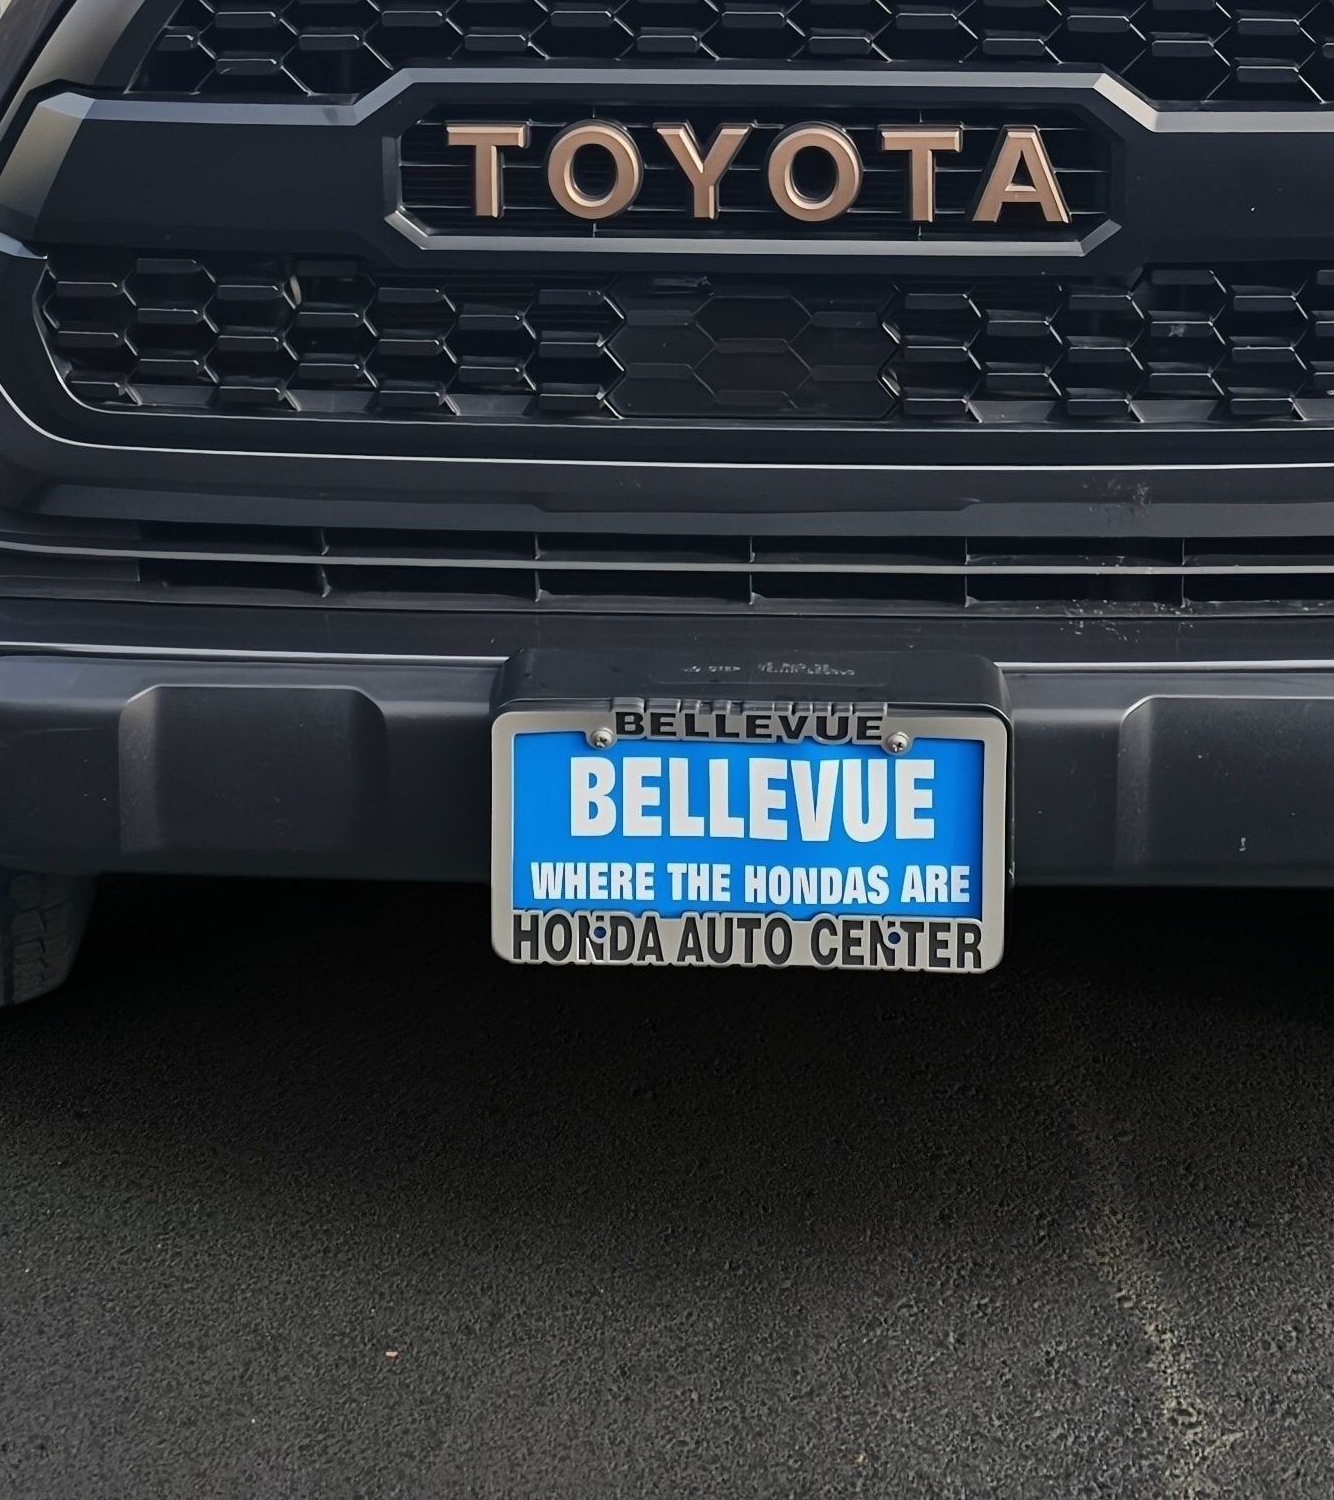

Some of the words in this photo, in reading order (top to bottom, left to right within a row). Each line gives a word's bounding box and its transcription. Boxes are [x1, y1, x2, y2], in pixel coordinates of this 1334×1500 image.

[445, 119, 1072, 224] TOYOTA
[615, 711, 883, 741] BELLEVUE
[570, 756, 935, 842] BELLEVUE
[530, 862, 655, 900] WHERE
[667, 863, 731, 902] THE
[744, 865, 889, 905] HONDAS
[901, 865, 970, 903] ARE
[512, 913, 664, 962] HONDA
[677, 916, 793, 966] AUTO
[810, 918, 982, 969] CENTER
